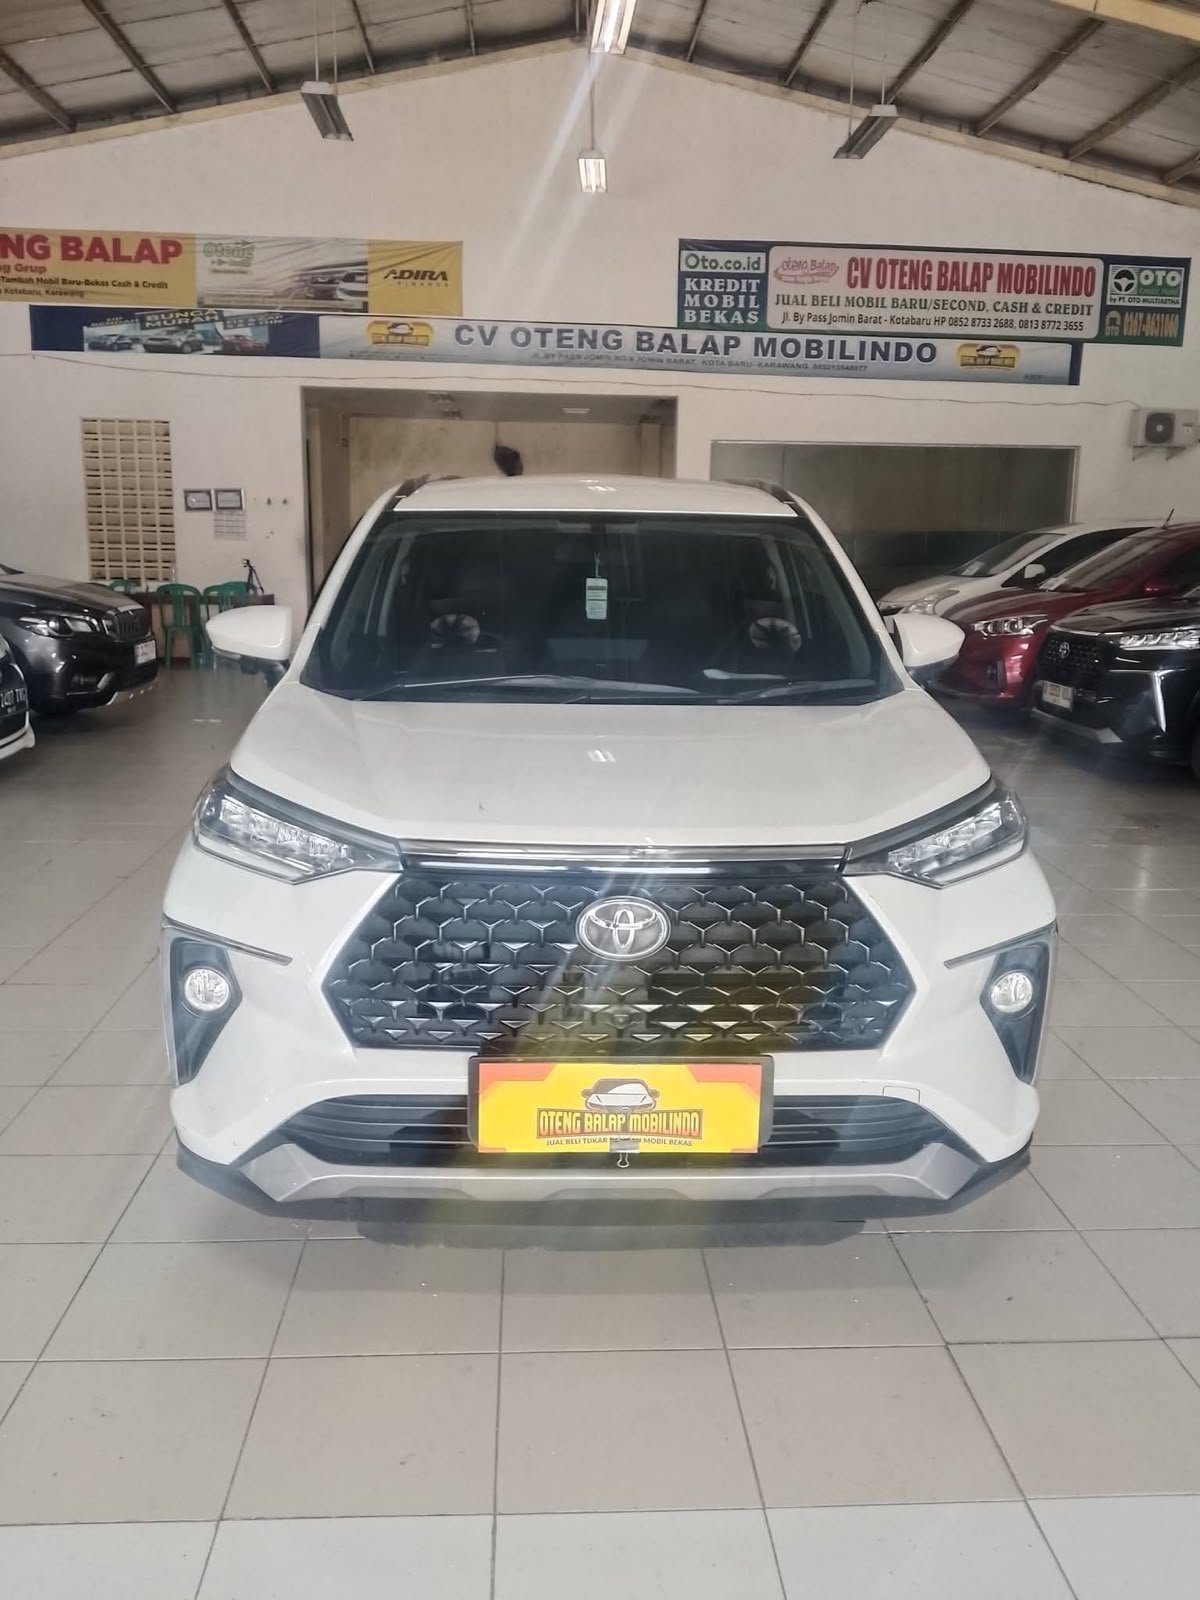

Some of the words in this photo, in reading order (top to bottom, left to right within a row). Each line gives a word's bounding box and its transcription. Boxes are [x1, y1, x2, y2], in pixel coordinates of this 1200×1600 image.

[0, 233, 51, 261] NG
[60, 235, 183, 265] BALAP
[15, 263, 47, 274] Grup
[685, 253, 761, 271] Oto.co.id
[36, 277, 60, 286] Mobil
[111, 280, 132, 288] Cash
[142, 281, 168, 289] Credit
[384, 270, 448, 281] ADIRA
[847, 257, 873, 289] CV
[876, 258, 933, 292] OTENG
[937, 260, 994, 294] BALAP
[998, 262, 1097, 298] MOBILINDO
[1139, 269, 1181, 287] OTO
[685, 278, 760, 292] KREDIT
[684, 294, 760, 308] MOBIL
[775, 294, 807, 306] JUAL
[811, 294, 841, 307] BELI
[845, 296, 887, 309] MOBIL
[993, 301, 1028, 314] CASH
[1031, 303, 1042, 314] &
[1046, 303, 1094, 317] CREDIT
[145, 315, 220, 329] MURAH
[684, 309, 760, 324] BEKAS
[793, 312, 804, 324] By
[806, 313, 828, 323] Pass
[828, 313, 855, 325] Jomin
[858, 314, 883, 325] Barat
[890, 314, 932, 327] Kotabaru
[934, 317, 947, 326] HP
[949, 317, 970, 328] 0852
[971, 318, 993, 328] 8733
[1019, 320, 1039, 330] 0813
[1041, 320, 1062, 331] 8772
[1063, 321, 1084, 332] 3655
[454, 325, 498, 346] CV
[510, 327, 623, 351] OTENG
[635, 331, 741, 356] BALAP
[753, 337, 938, 363] MOBILINDO
[702, 359, 726, 367] KOTA
[539, 1111, 581, 1136] OTENG
[584, 1112, 625, 1133] BALAP
[629, 1111, 700, 1136] MOBILINDO
[546, 1138, 564, 1146] JUAL
[668, 1138, 693, 1147] BEKAS
